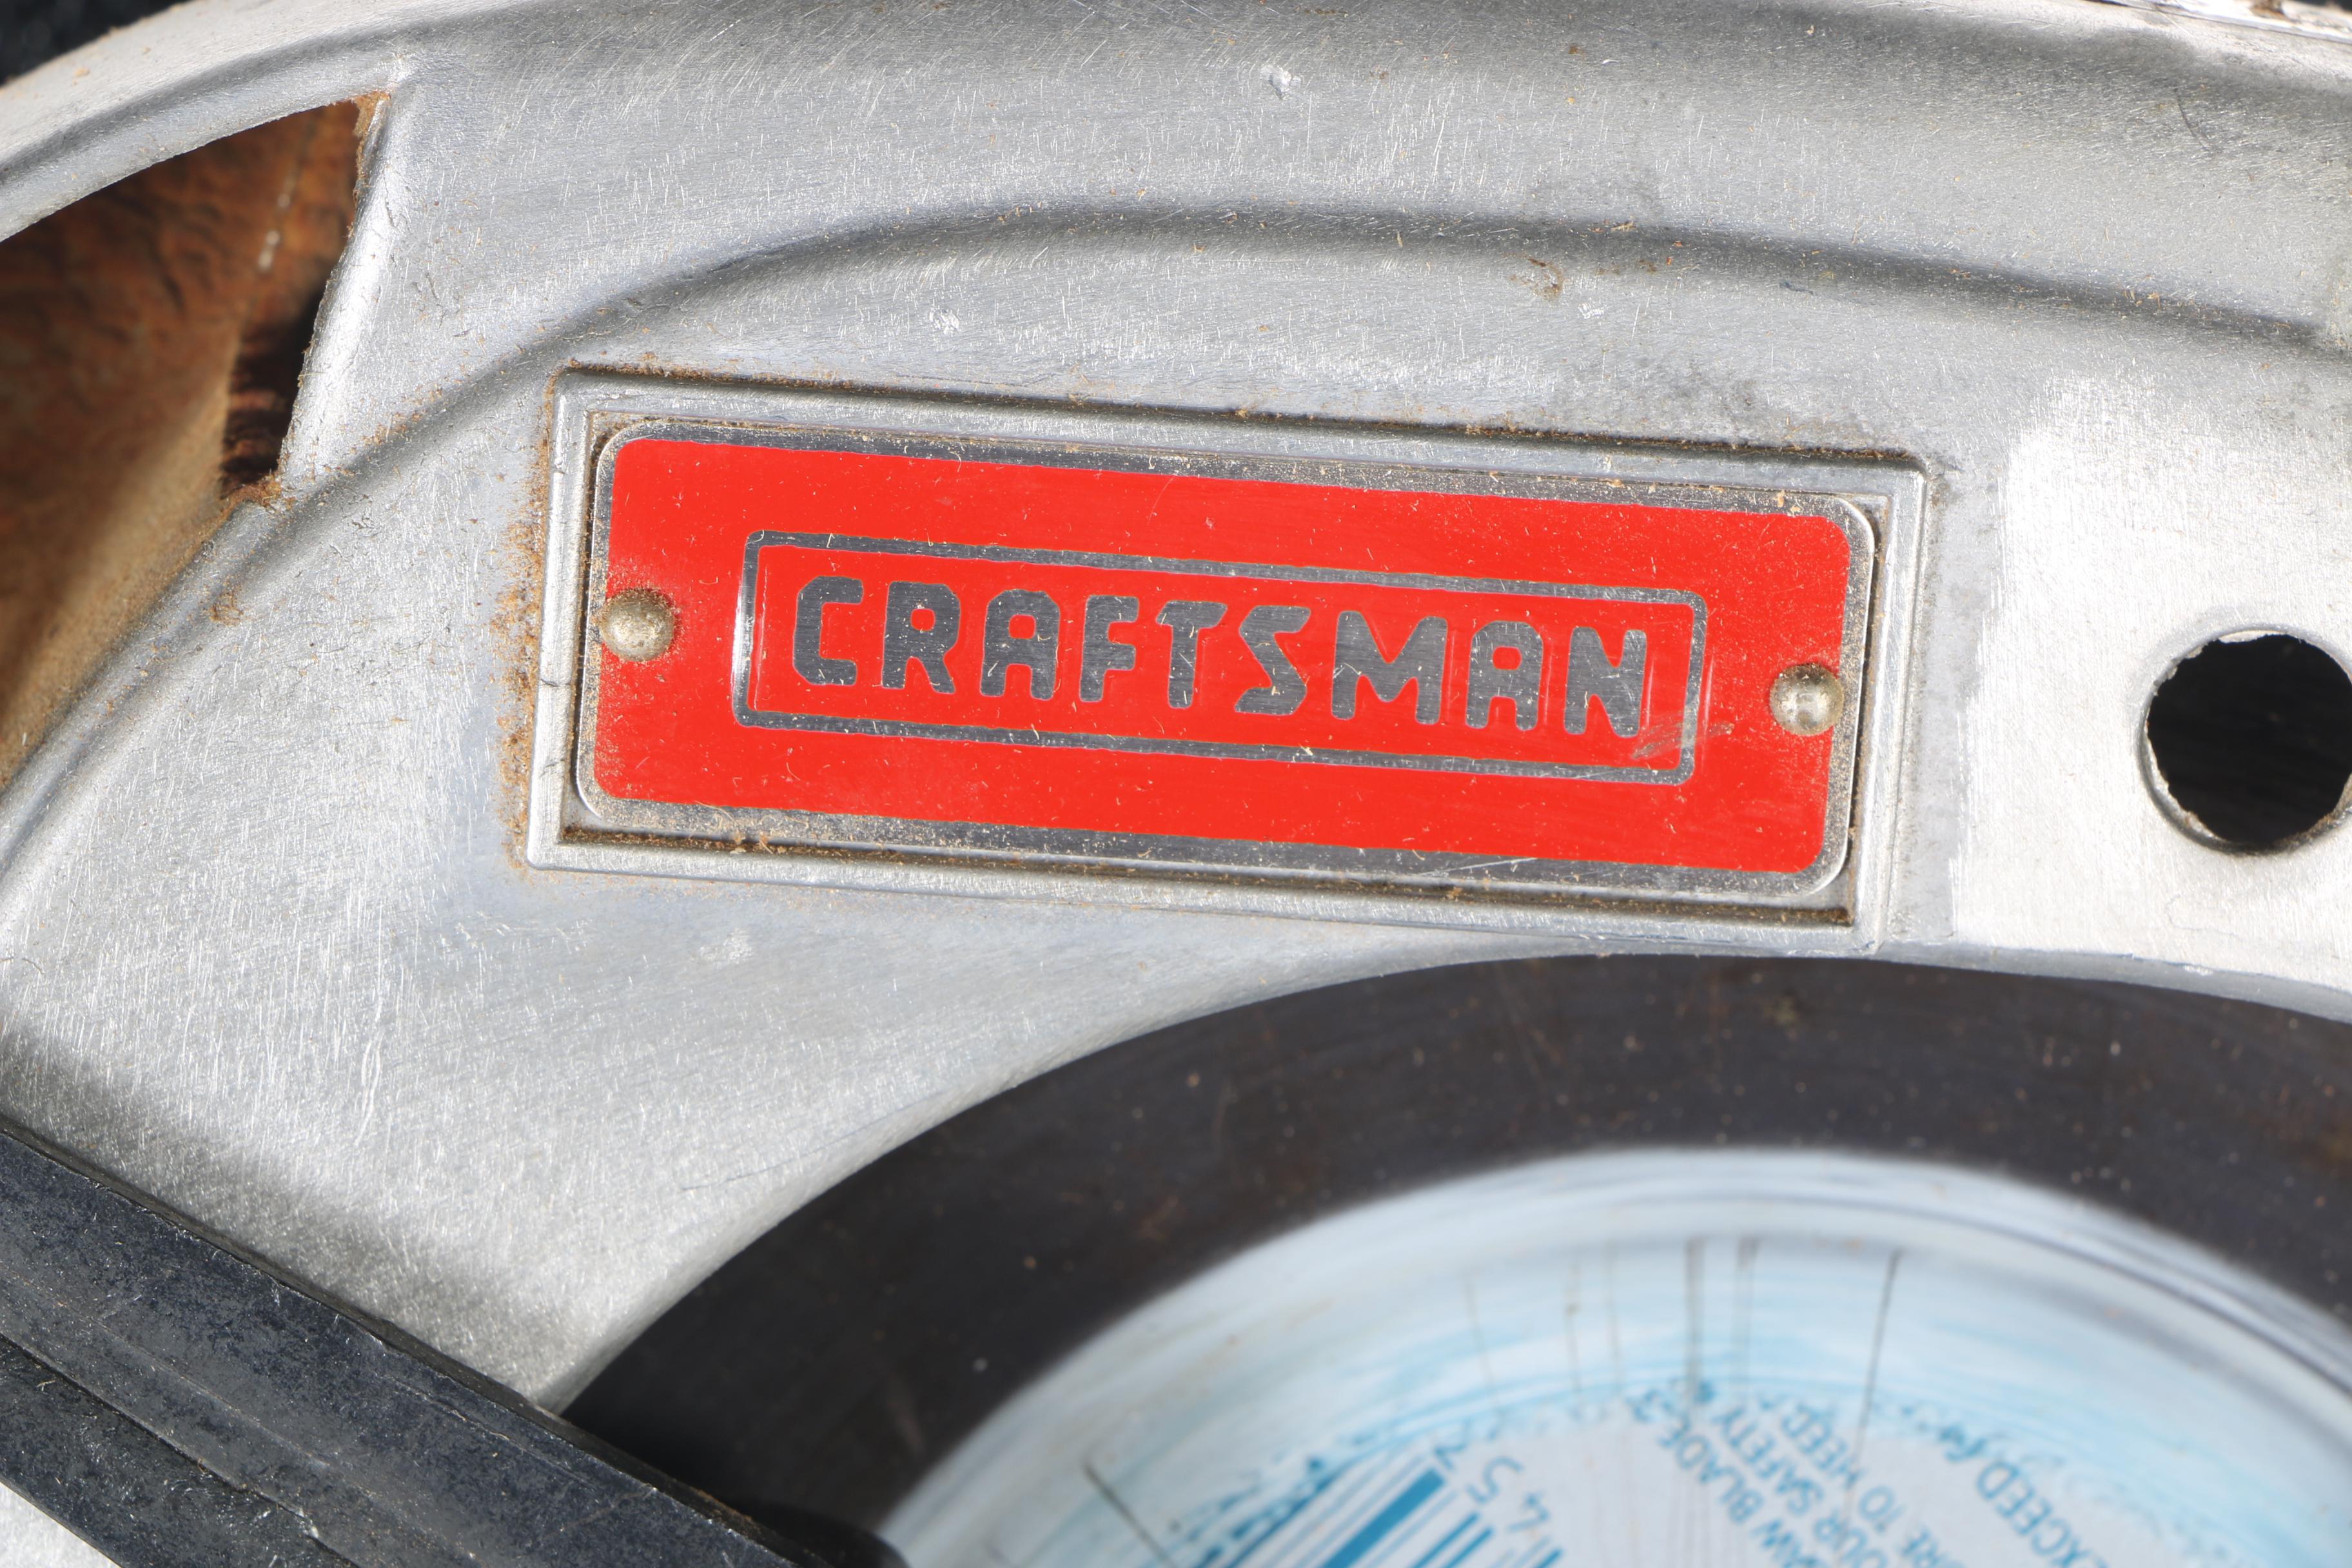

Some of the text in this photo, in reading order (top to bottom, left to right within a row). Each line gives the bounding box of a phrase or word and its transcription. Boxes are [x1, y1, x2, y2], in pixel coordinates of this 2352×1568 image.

[792, 574, 1647, 738] CRAFTSMAN
[1709, 1407, 1825, 1516] SAFETY
[1749, 1518, 1828, 1568] AW
[1857, 1483, 1906, 1535] TO
